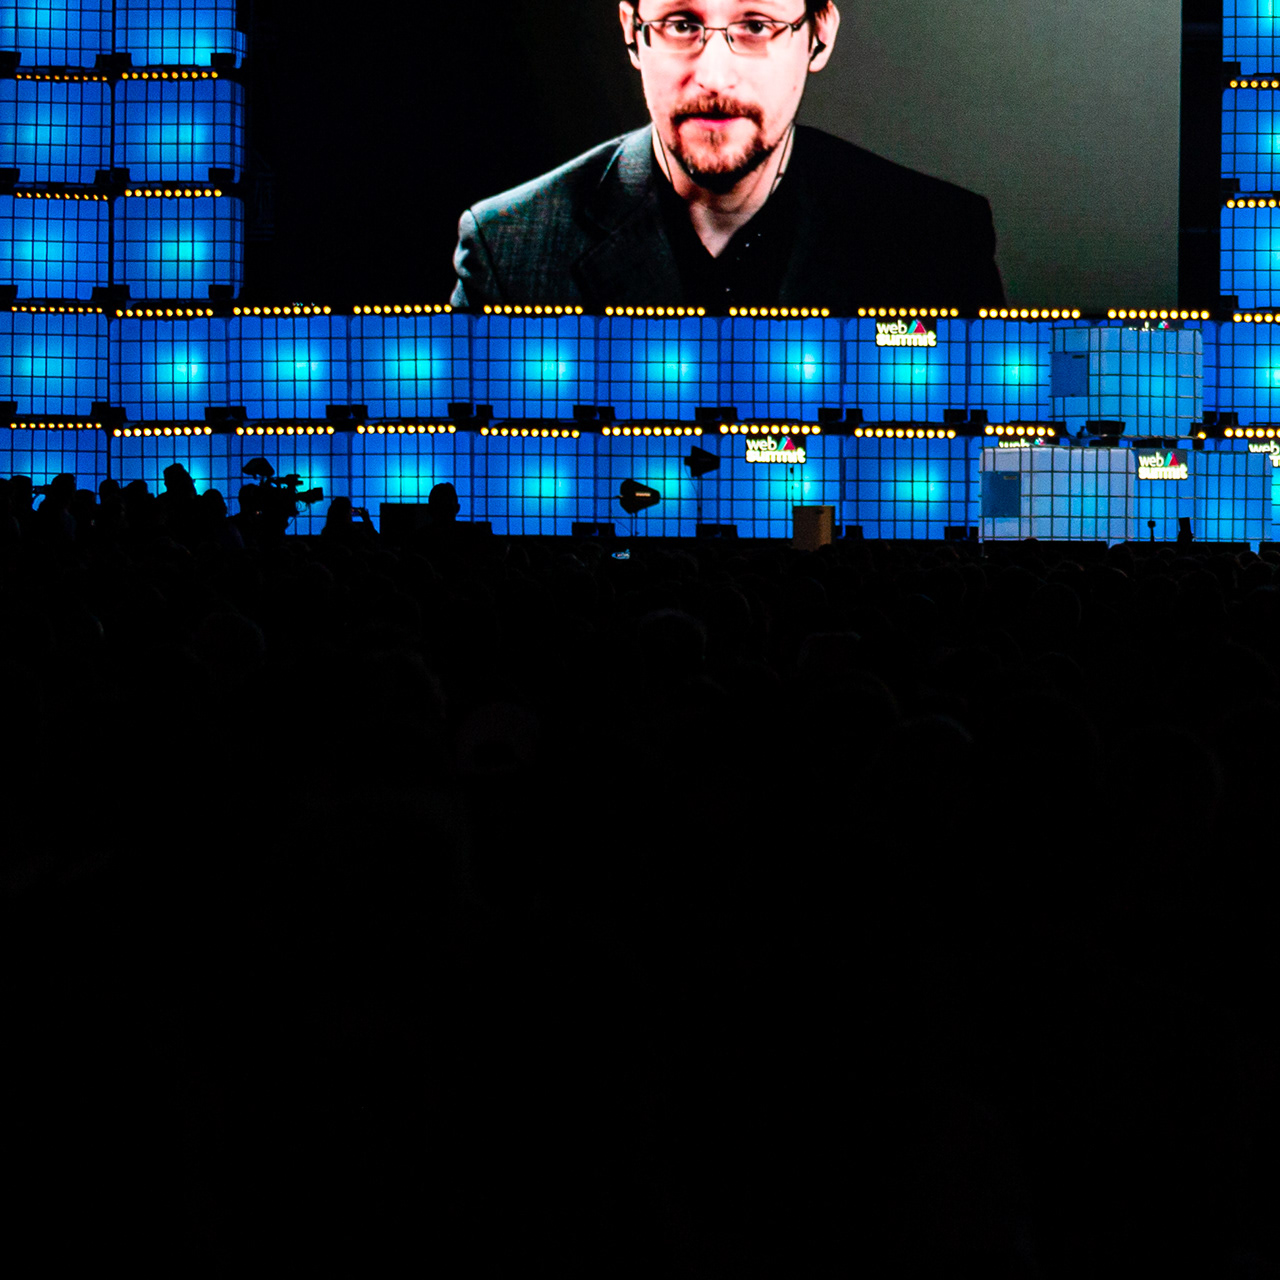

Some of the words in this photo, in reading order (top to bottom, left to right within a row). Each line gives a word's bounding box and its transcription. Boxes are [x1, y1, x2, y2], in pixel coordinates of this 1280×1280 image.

[876, 320, 907, 334] web
[876, 331, 936, 346] summit
[746, 436, 777, 450] web
[1249, 440, 1280, 455] web
[746, 447, 806, 463] summit
[1138, 452, 1164, 466] web
[1138, 463, 1188, 479] summit
